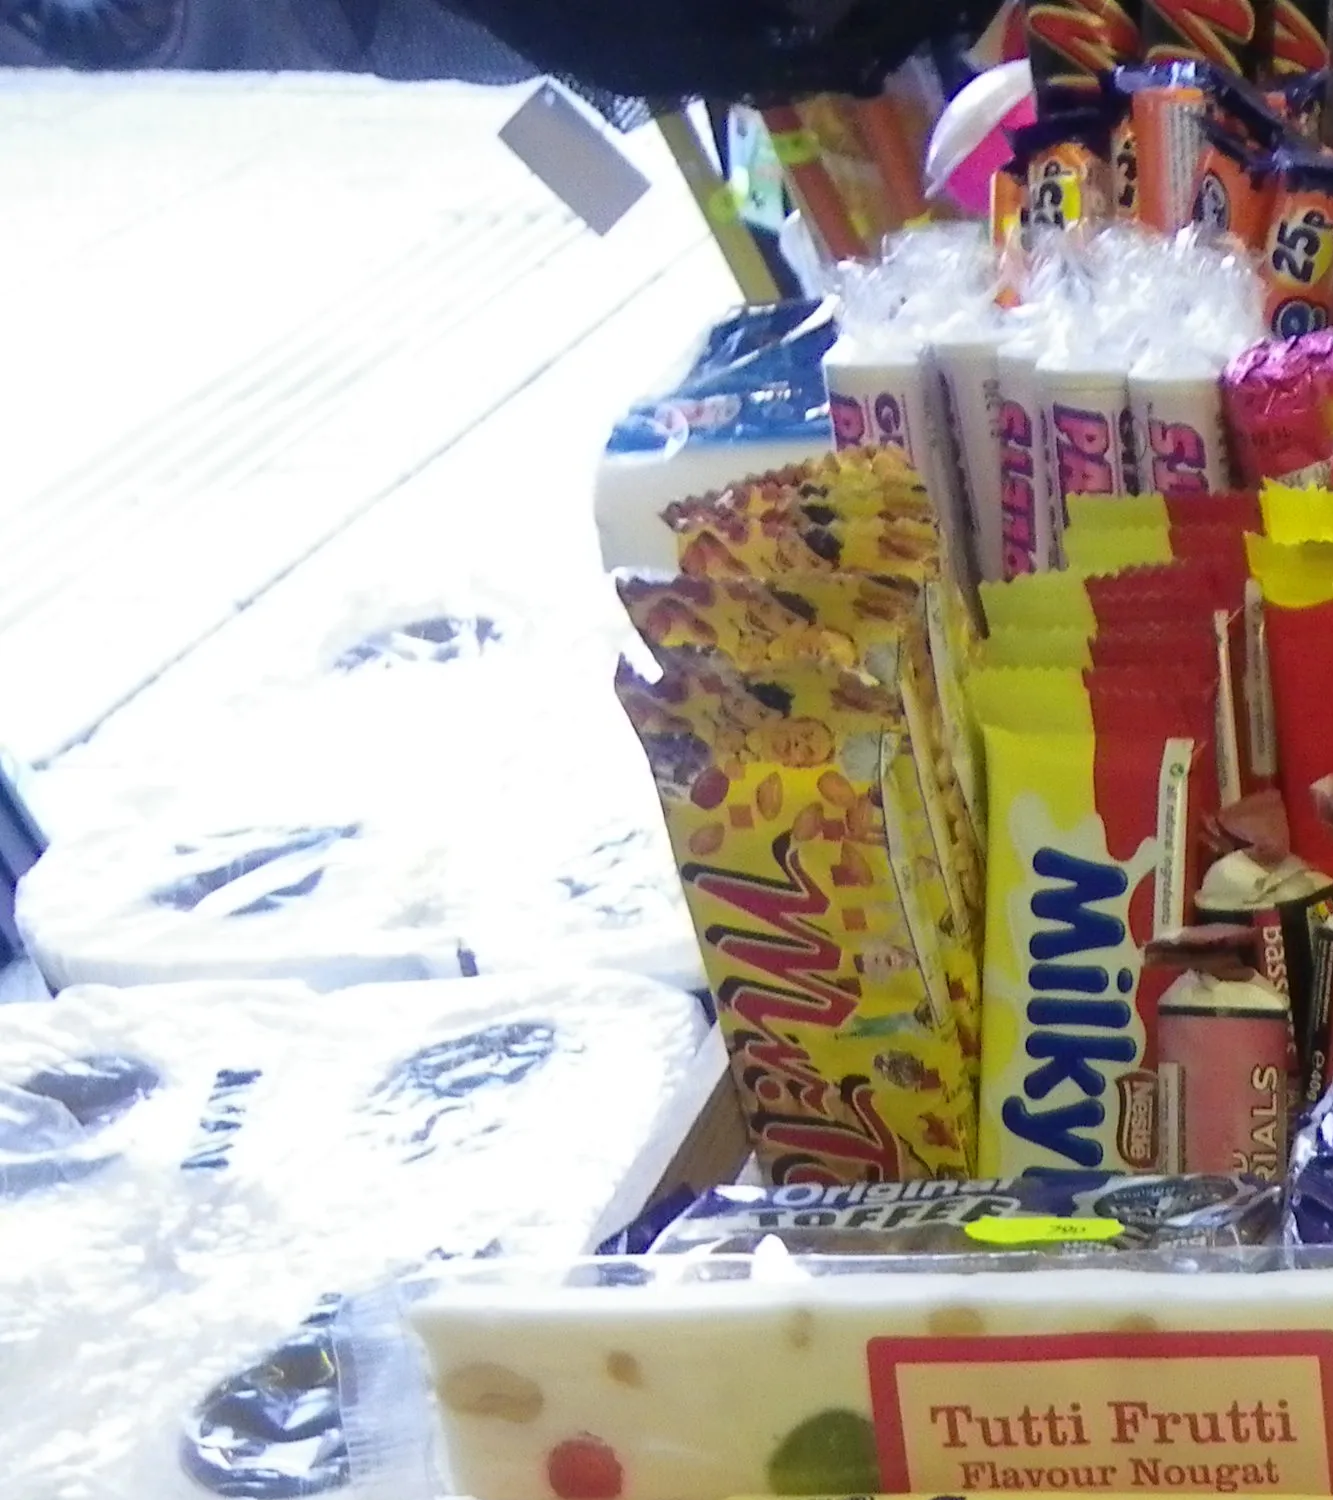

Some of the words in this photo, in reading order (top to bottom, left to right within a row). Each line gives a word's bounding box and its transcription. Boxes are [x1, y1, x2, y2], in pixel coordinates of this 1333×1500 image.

[1005, 846, 1140, 1174] Milky
[929, 1402, 1091, 1449] Tutti
[1106, 1398, 1299, 1448] Frutti
[959, 1459, 1122, 1491] Flavour
[1127, 1457, 1281, 1494] Nougat
